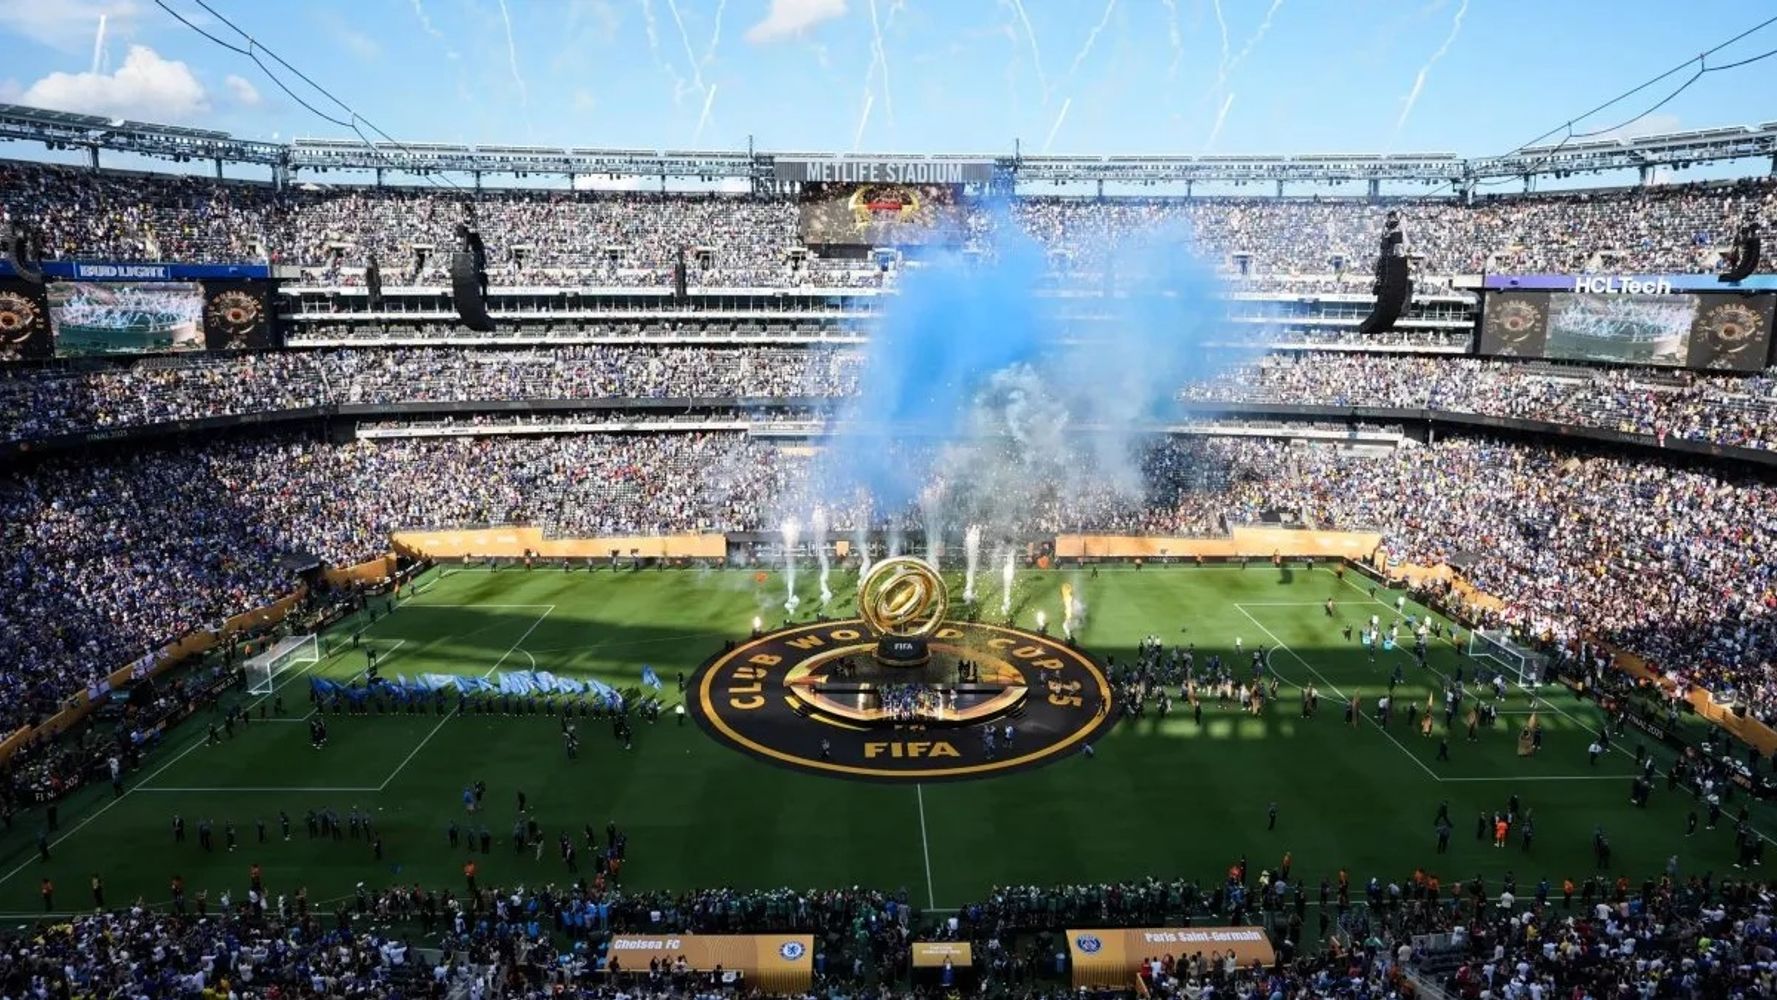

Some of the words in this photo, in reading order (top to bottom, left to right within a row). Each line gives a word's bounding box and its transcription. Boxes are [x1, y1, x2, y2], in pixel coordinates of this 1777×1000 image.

[806, 162, 880, 182] METLIFE
[886, 162, 963, 184] STADIUM
[79, 264, 118, 277] BUD
[119, 265, 166, 278] LIGHT
[1575, 276, 1672, 295] HCLTech
[894, 642, 913, 651] FIFA
[728, 653, 783, 710] CLUB
[785, 628, 964, 650] WOD
[987, 638, 1065, 670] CUP
[863, 741, 961, 758] FIFA
[614, 938, 662, 950] Chelsea
[665, 938, 681, 950] FC
[1145, 932, 1178, 943] Paris
[1179, 930, 1262, 942] Saint-Germain
